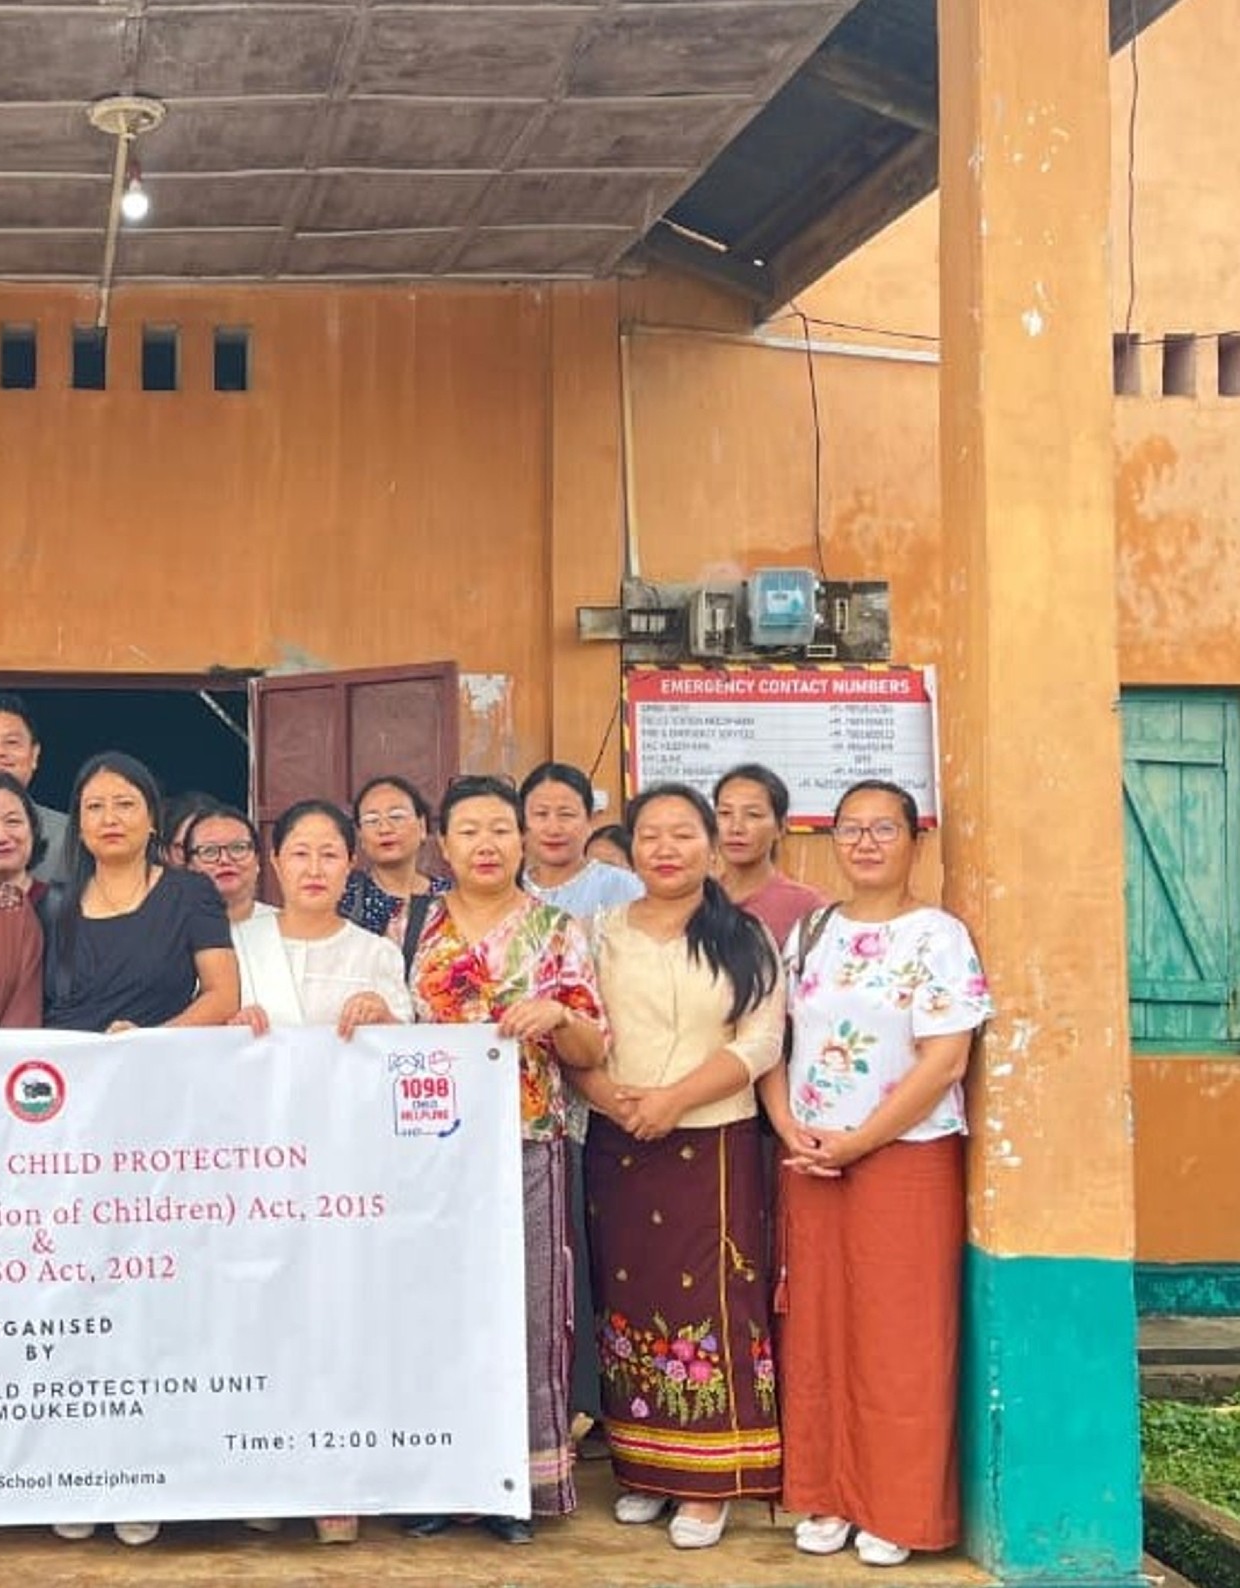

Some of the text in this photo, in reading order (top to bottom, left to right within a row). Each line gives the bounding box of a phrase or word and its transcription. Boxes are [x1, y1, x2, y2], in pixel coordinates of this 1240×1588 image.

[661, 679, 909, 694] EMERGENCY CONTACT NUMBERS
[400, 1077, 449, 1099] 1098
[8, 1151, 101, 1175] CHILD
[113, 1146, 308, 1173] PROTECTION
[53, 1199, 84, 1225] of
[93, 1195, 236, 1225] Children)
[248, 1196, 306, 1222] Act,
[318, 1194, 386, 1219] 2015
[32, 1230, 55, 1254] &
[38, 1258, 95, 1283] Act,
[108, 1255, 176, 1280] 2012
[26, 1344, 54, 1361] BY
[33, 1377, 198, 1398] PROTECTION
[210, 1375, 269, 1393] UNIT
[224, 1430, 453, 1451] Time: 12:00 Noon
[59, 1470, 166, 1488] Medziphema
